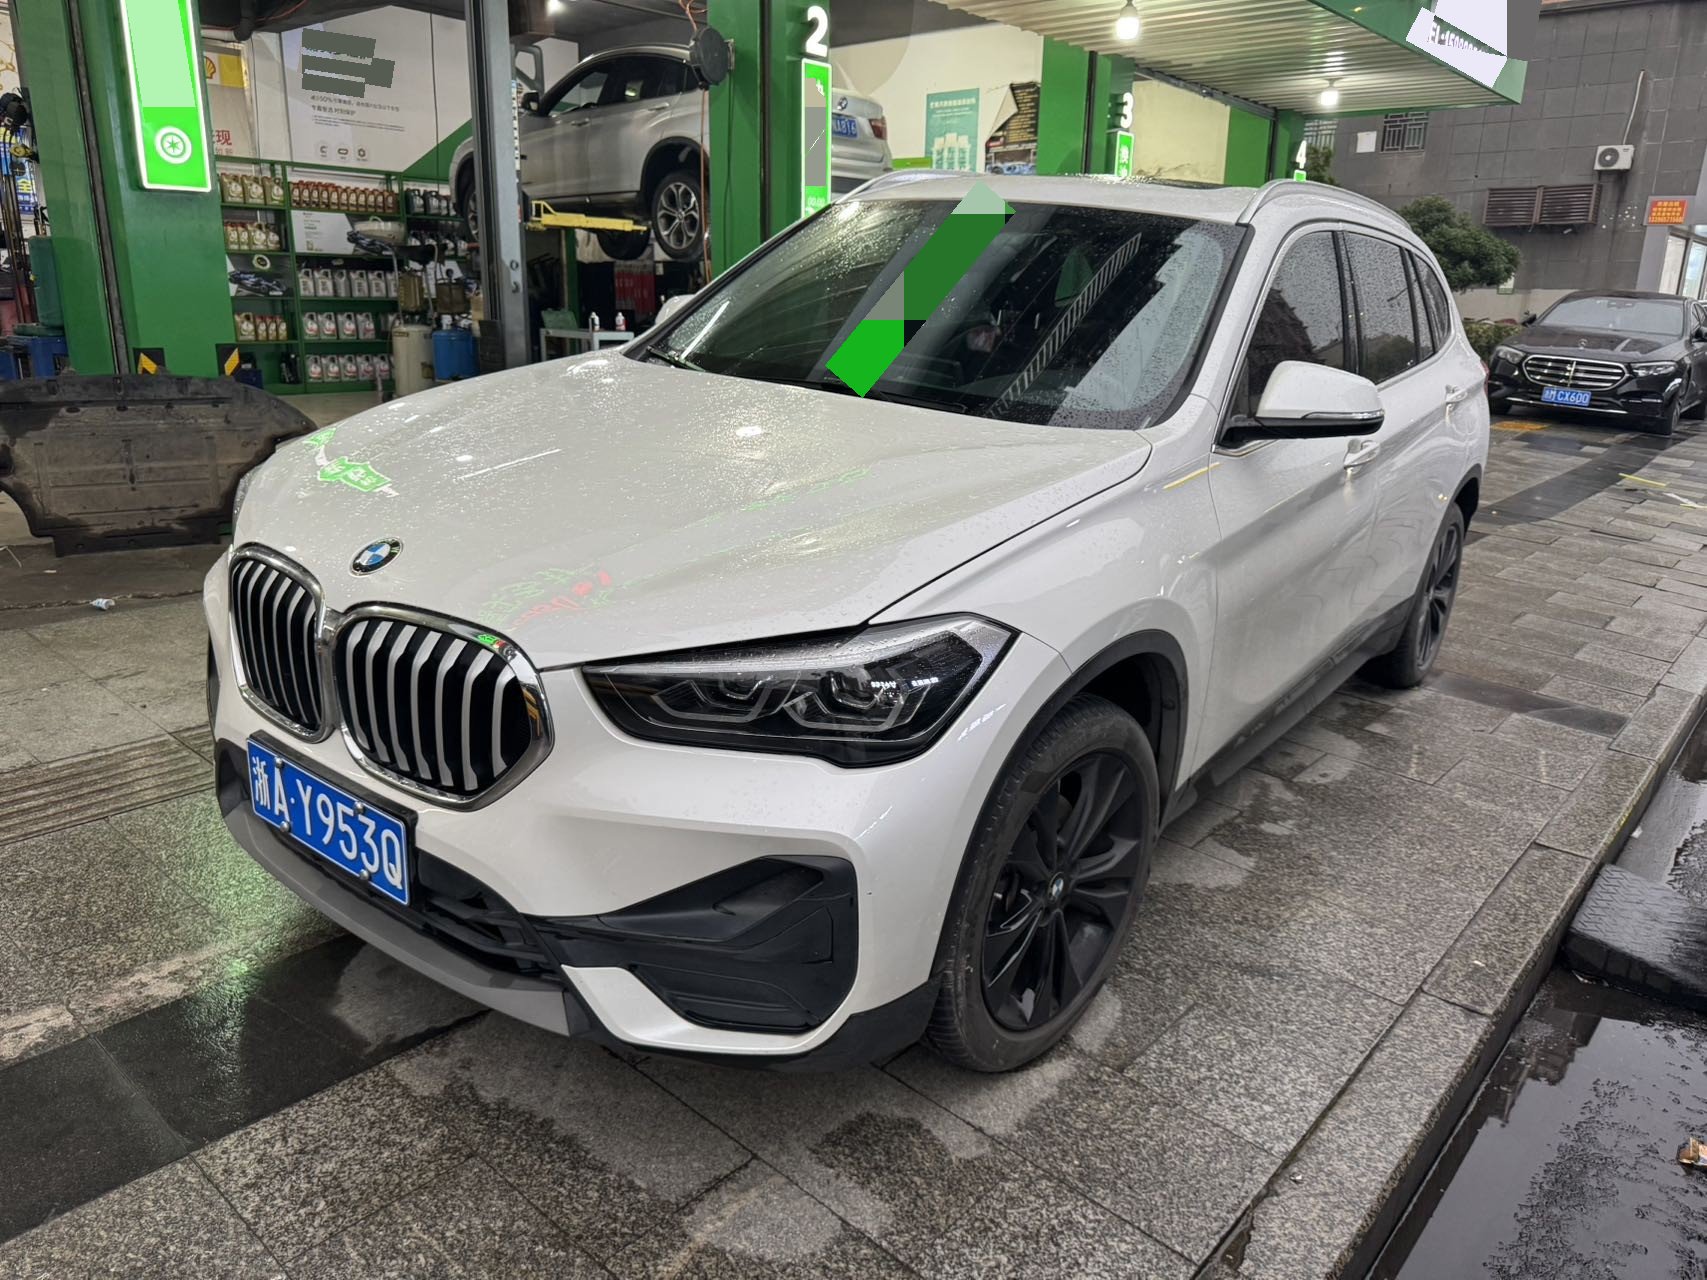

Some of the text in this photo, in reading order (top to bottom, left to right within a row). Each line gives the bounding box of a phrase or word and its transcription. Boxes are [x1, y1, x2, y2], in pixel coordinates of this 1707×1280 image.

[805, 5, 829, 58] 2
[1120, 92, 1134, 129] 3
[1296, 140, 1307, 169] 4
